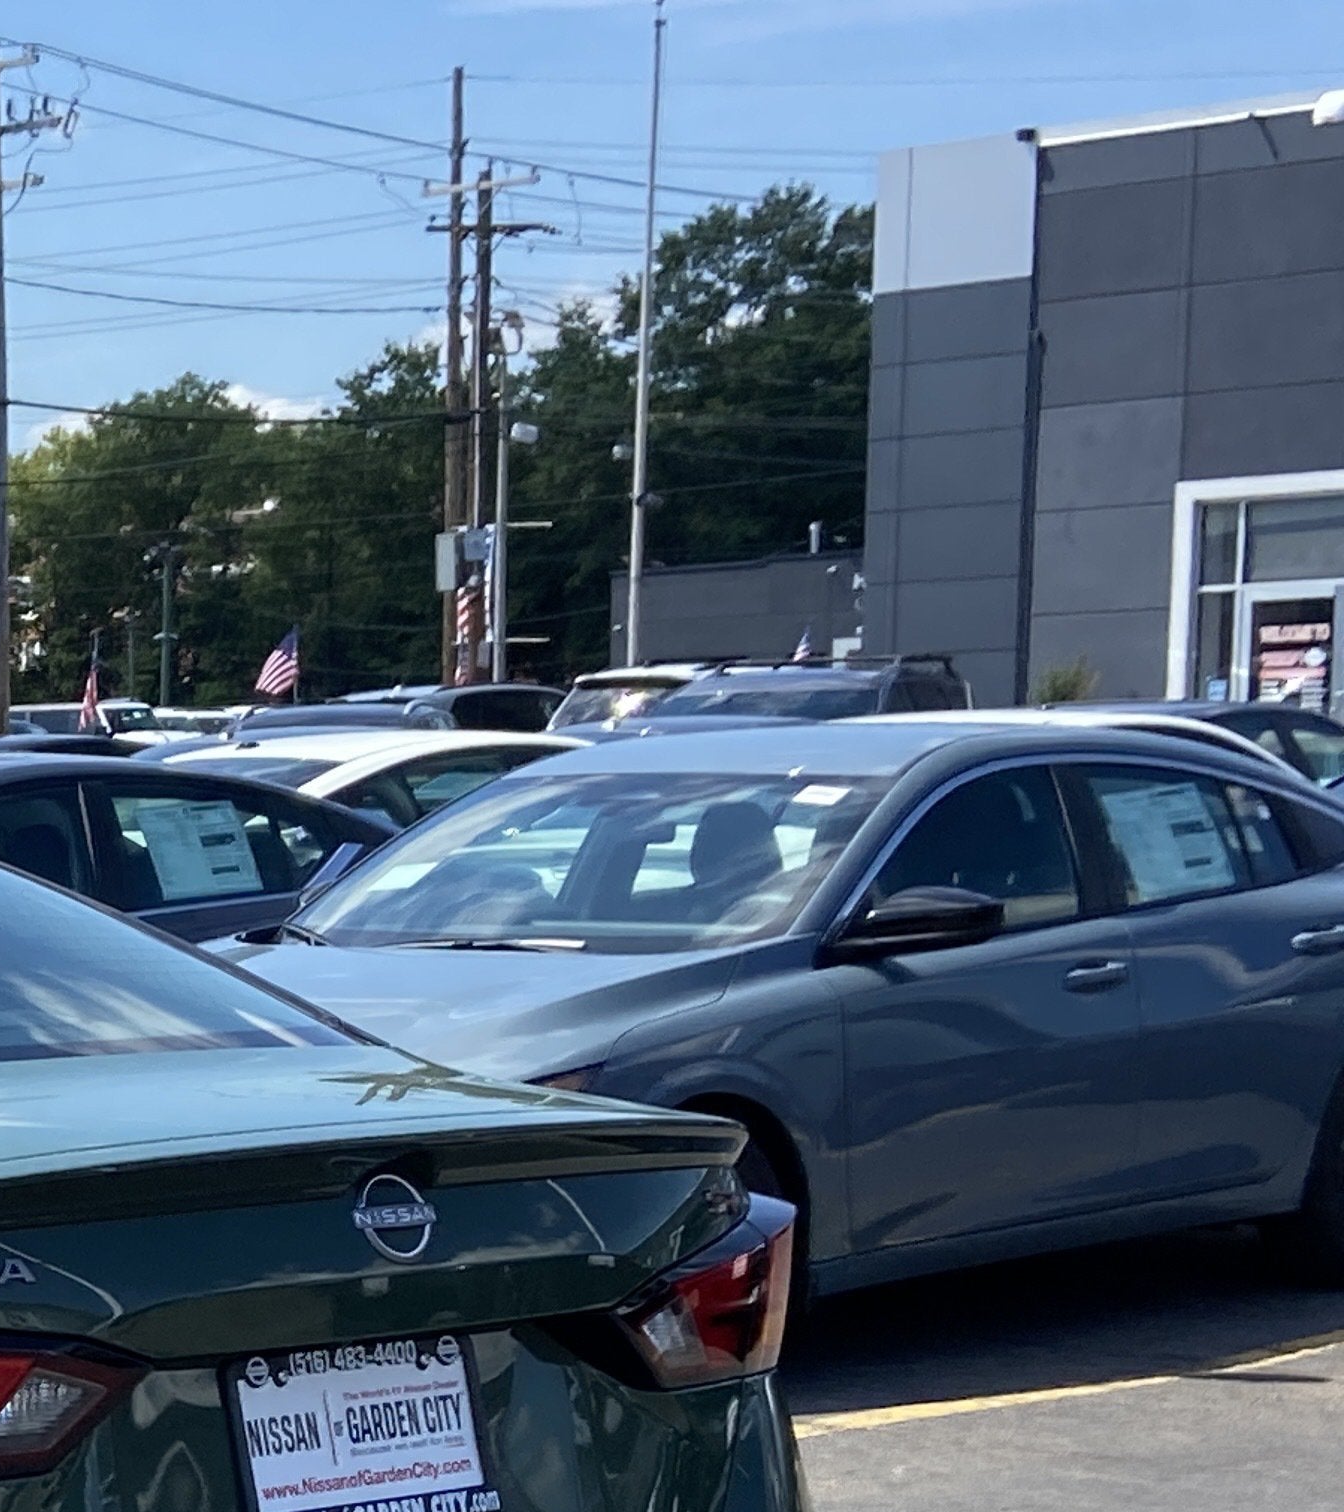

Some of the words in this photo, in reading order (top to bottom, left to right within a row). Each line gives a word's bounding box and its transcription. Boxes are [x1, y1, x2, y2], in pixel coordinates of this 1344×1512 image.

[353, 1206, 437, 1226] NISSAN
[288, 1348, 331, 1377] (516)
[333, 1340, 417, 1370] 483-4400
[246, 1411, 322, 1458] NISSAN
[345, 1398, 422, 1445] GARDEN
[422, 1392, 463, 1434] CITY
[261, 1457, 472, 1500] www.NissanofGardenCity.com
